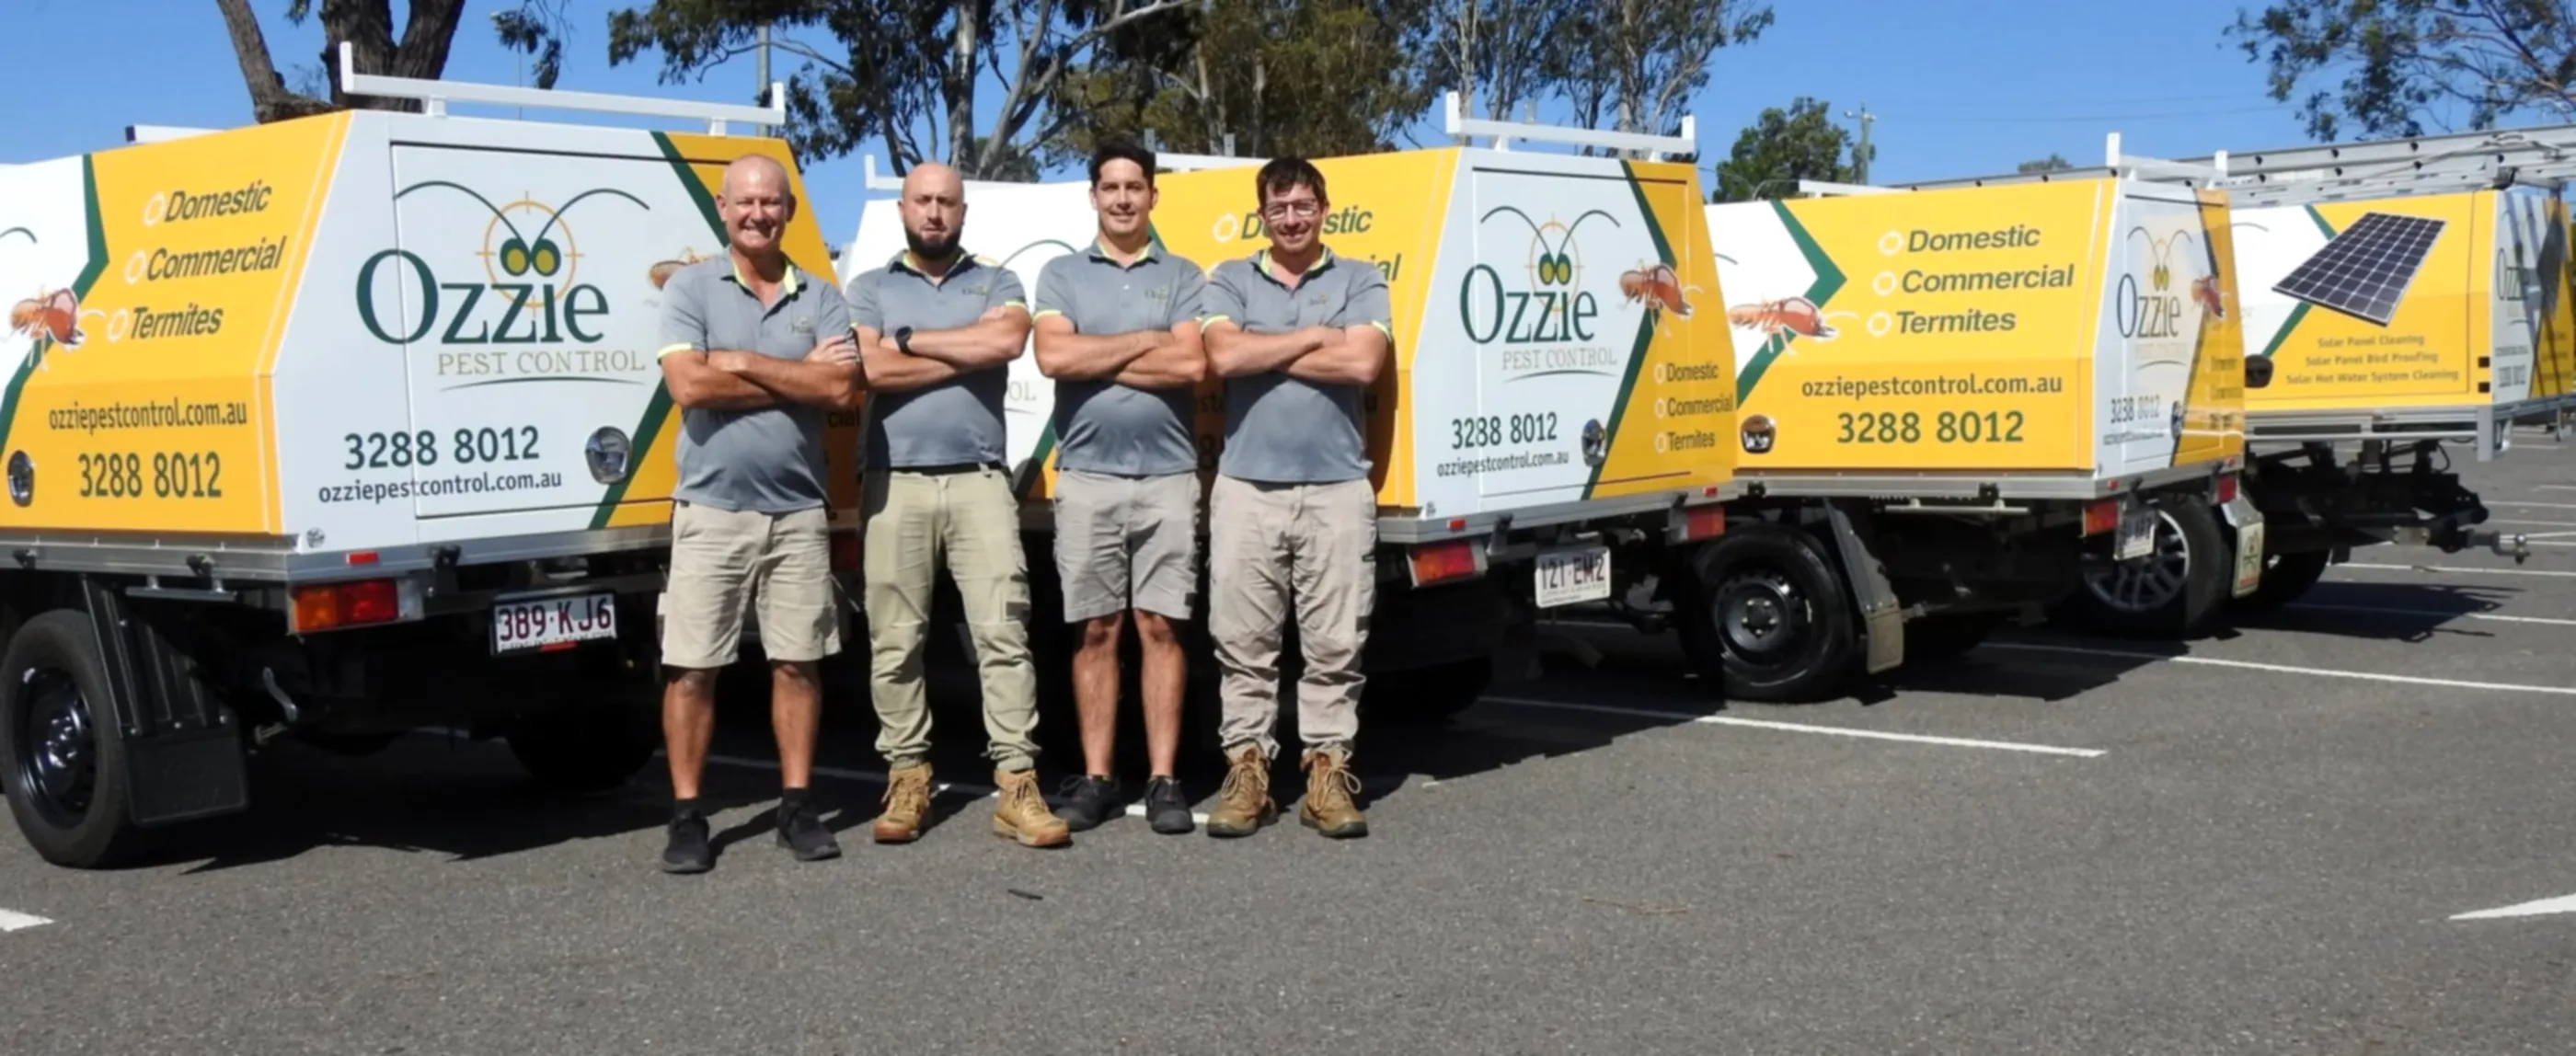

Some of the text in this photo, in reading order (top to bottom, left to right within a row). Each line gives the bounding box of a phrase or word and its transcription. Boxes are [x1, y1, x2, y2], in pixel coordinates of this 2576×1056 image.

[165, 180, 271, 223] Domestic
[1240, 204, 1373, 240] Dstic
[1908, 224, 2041, 253] Domestic
[146, 236, 287, 281] Commercial
[1901, 263, 2075, 294] Commercial
[356, 248, 609, 345] Ozzie
[1460, 263, 1598, 345] Ozzie
[2116, 272, 2181, 339] Ozzie
[130, 303, 224, 340] Termites
[1896, 308, 2017, 335] Termites
[2317, 334, 2425, 349] Solar Panel Cleaning
[437, 350, 646, 376] PEST CONTROL
[1502, 347, 1617, 370] PEST CONTROL
[1665, 362, 1719, 382] Domestic
[2306, 355, 2331, 366] Solar
[2335, 354, 2363, 365] Panel
[1801, 373, 2063, 400] ozziepestcontrol.com.au
[2412, 370, 2459, 382] Cleaning
[49, 397, 247, 435] ozziepestcontrol.com.au
[1667, 394, 1734, 418] Commercial
[1452, 412, 1558, 450] 3288 8012
[1667, 430, 1716, 451] Termites
[1837, 410, 2024, 443] 3288 8012
[344, 425, 540, 470] 3288 8012
[1437, 449, 1569, 477] ozziepestcontrol.com.au
[79, 452, 222, 498] 3288 8012
[318, 471, 562, 504] ozziepestcontrol.com.au
